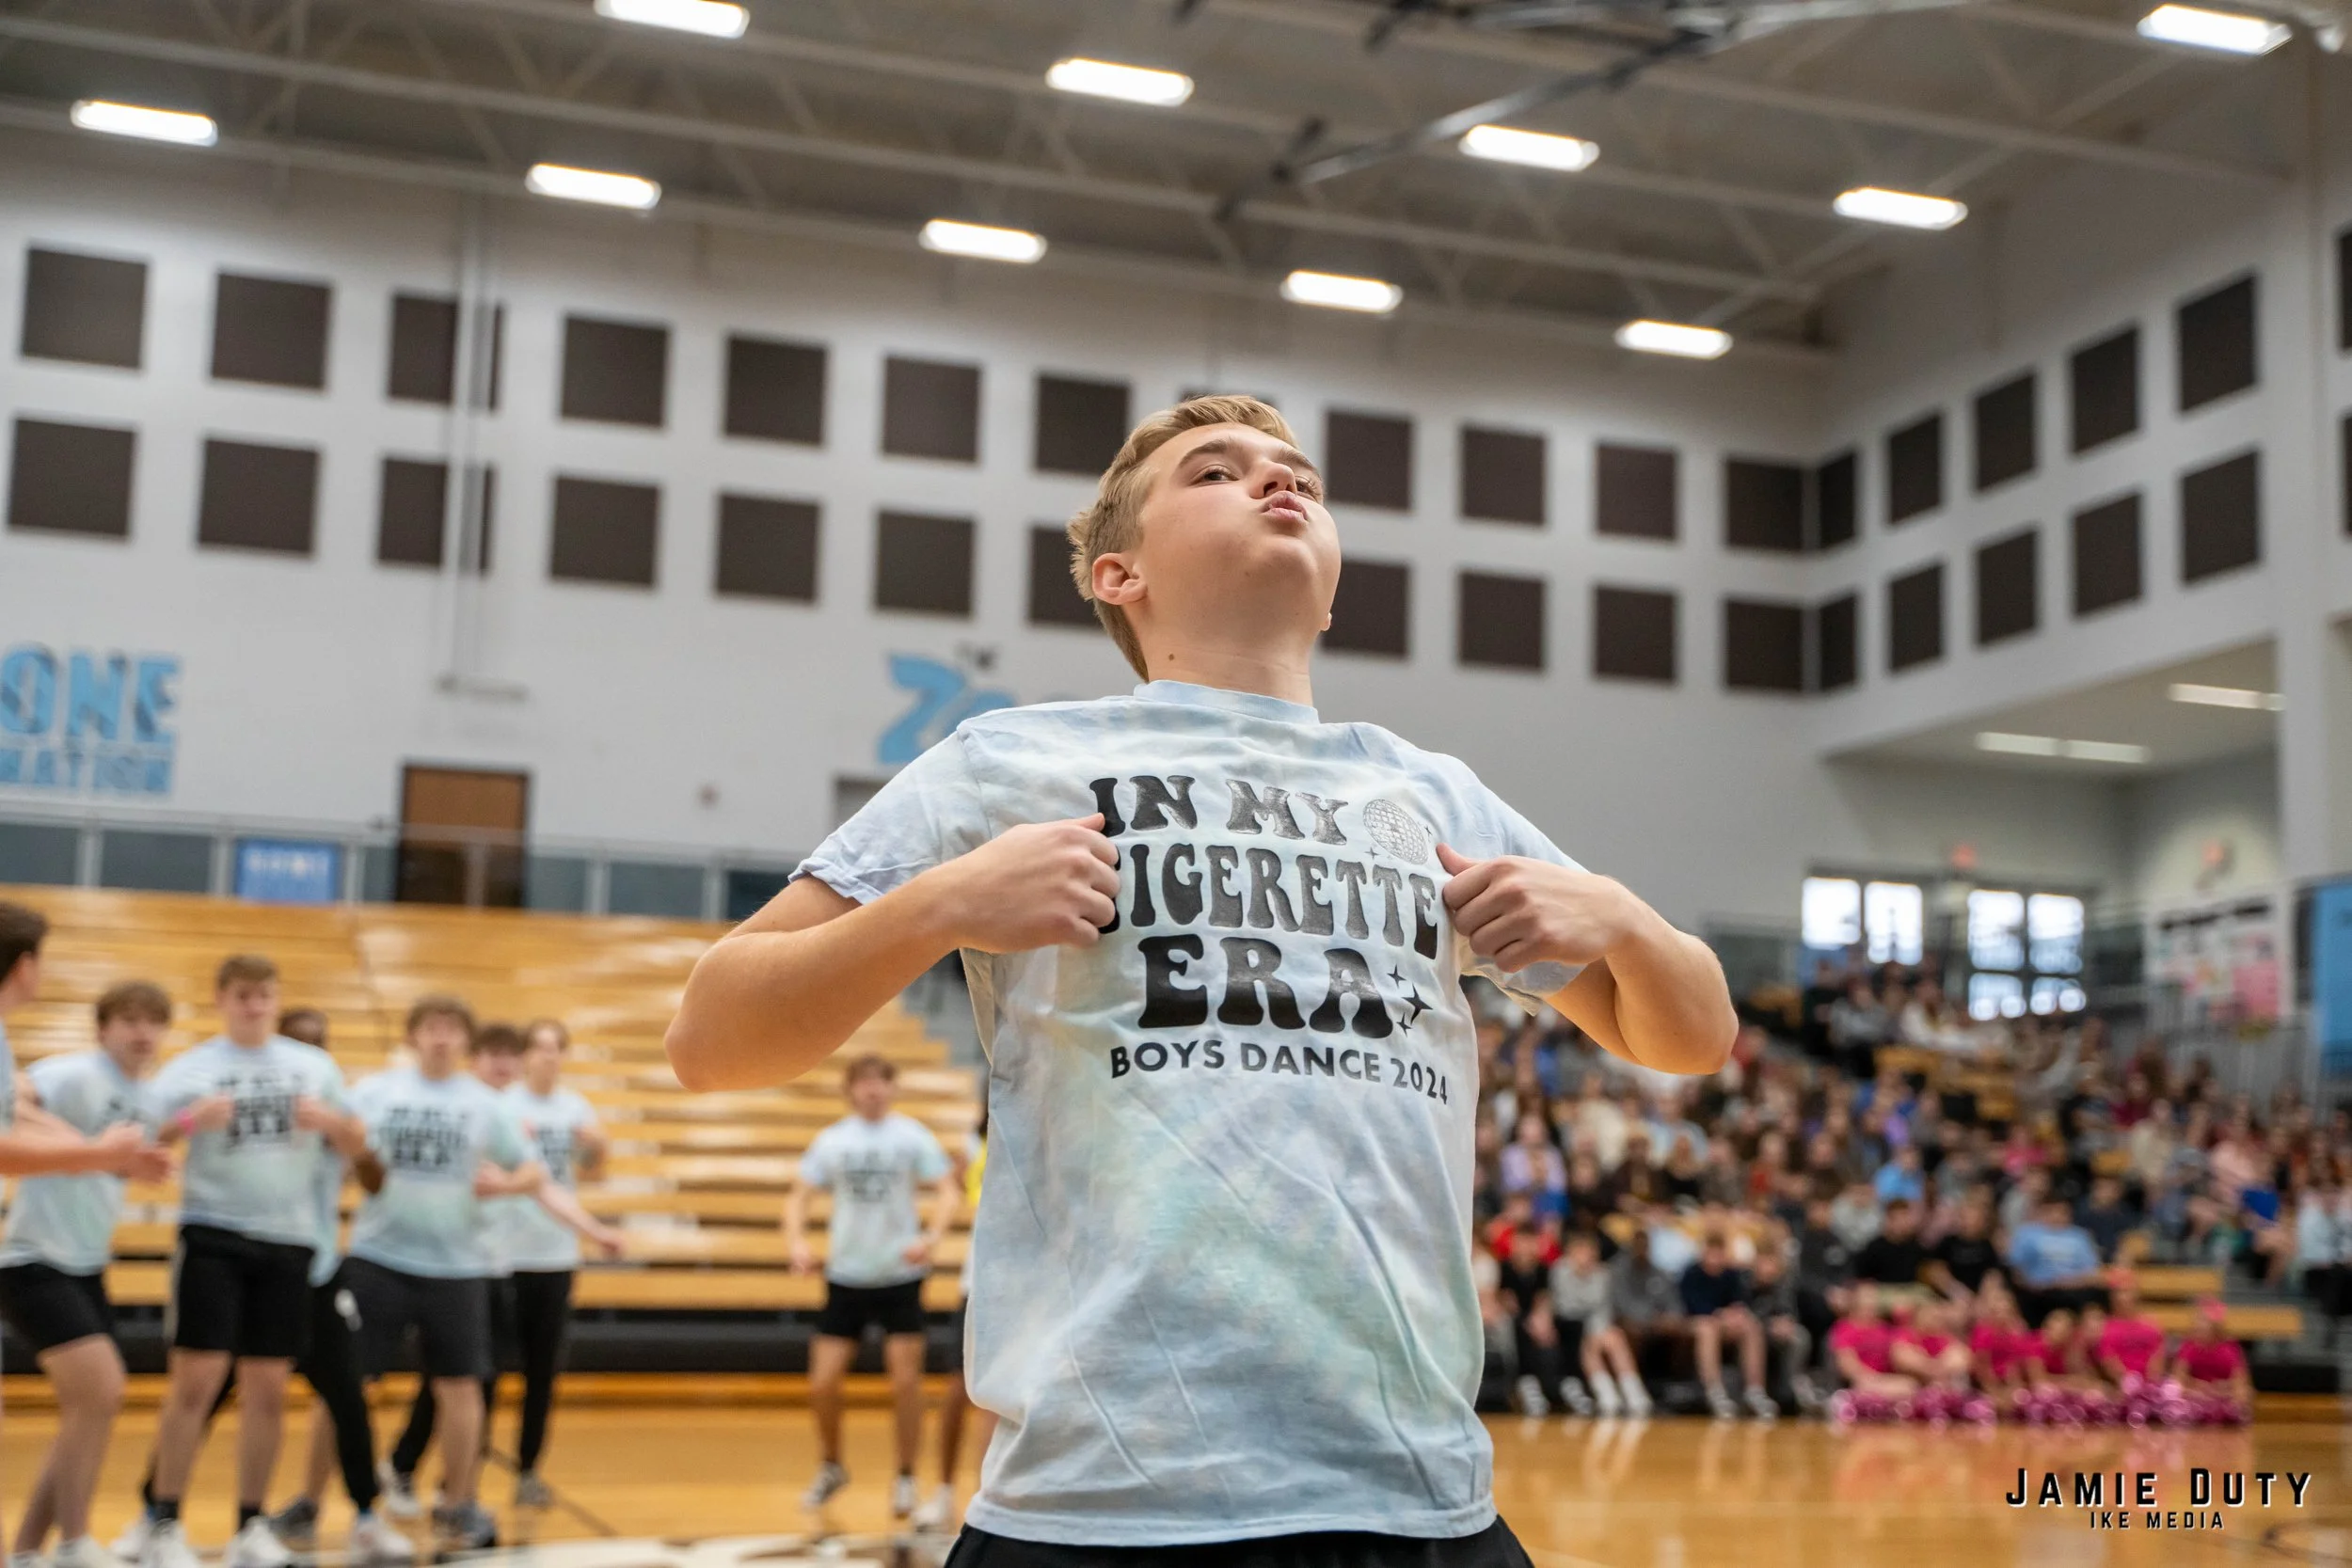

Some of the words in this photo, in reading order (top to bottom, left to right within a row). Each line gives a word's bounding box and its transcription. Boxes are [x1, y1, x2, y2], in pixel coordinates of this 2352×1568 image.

[1089, 775, 1198, 837] IN
[1226, 779, 1348, 846] MY
[1099, 843, 1438, 960] IGERETTE
[1137, 933, 1393, 1039] ERA
[1111, 1039, 1225, 1079] BOYS
[1240, 1042, 1381, 1084] DANCE
[1391, 1056, 1448, 1105] 2024
